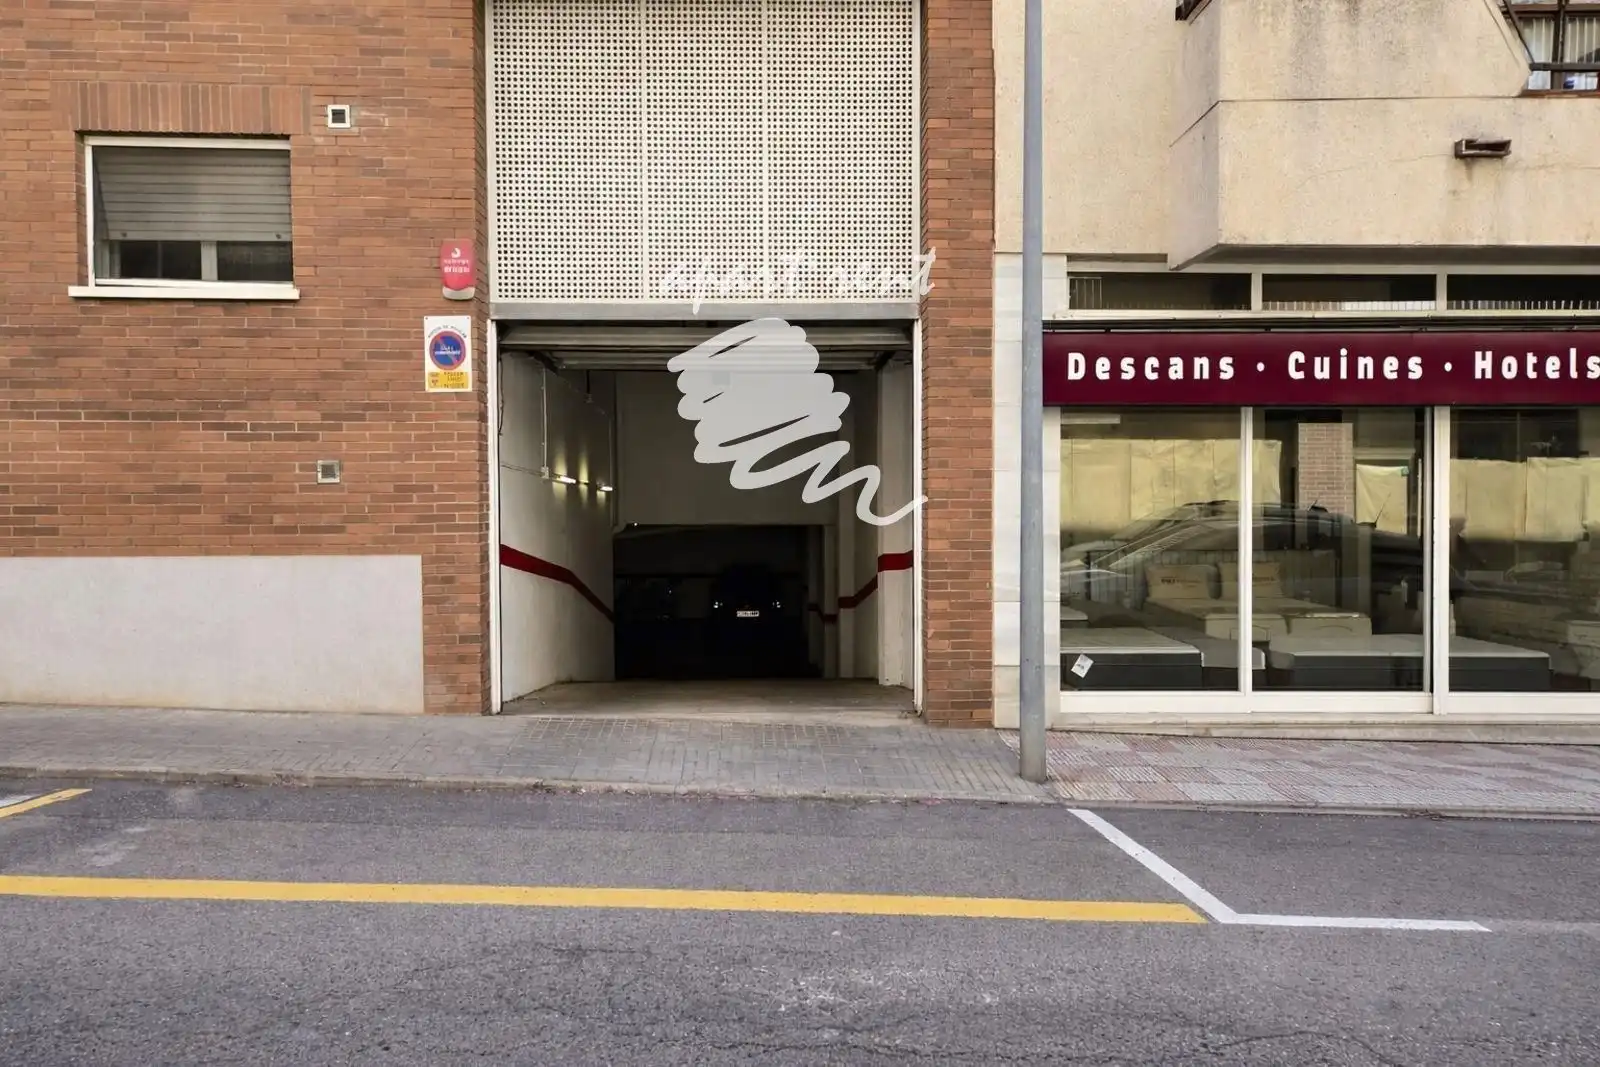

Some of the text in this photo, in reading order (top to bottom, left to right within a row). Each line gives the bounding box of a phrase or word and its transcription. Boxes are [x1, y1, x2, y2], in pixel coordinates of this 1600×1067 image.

[1067, 347, 1600, 381] Descans Cuines Hotels
